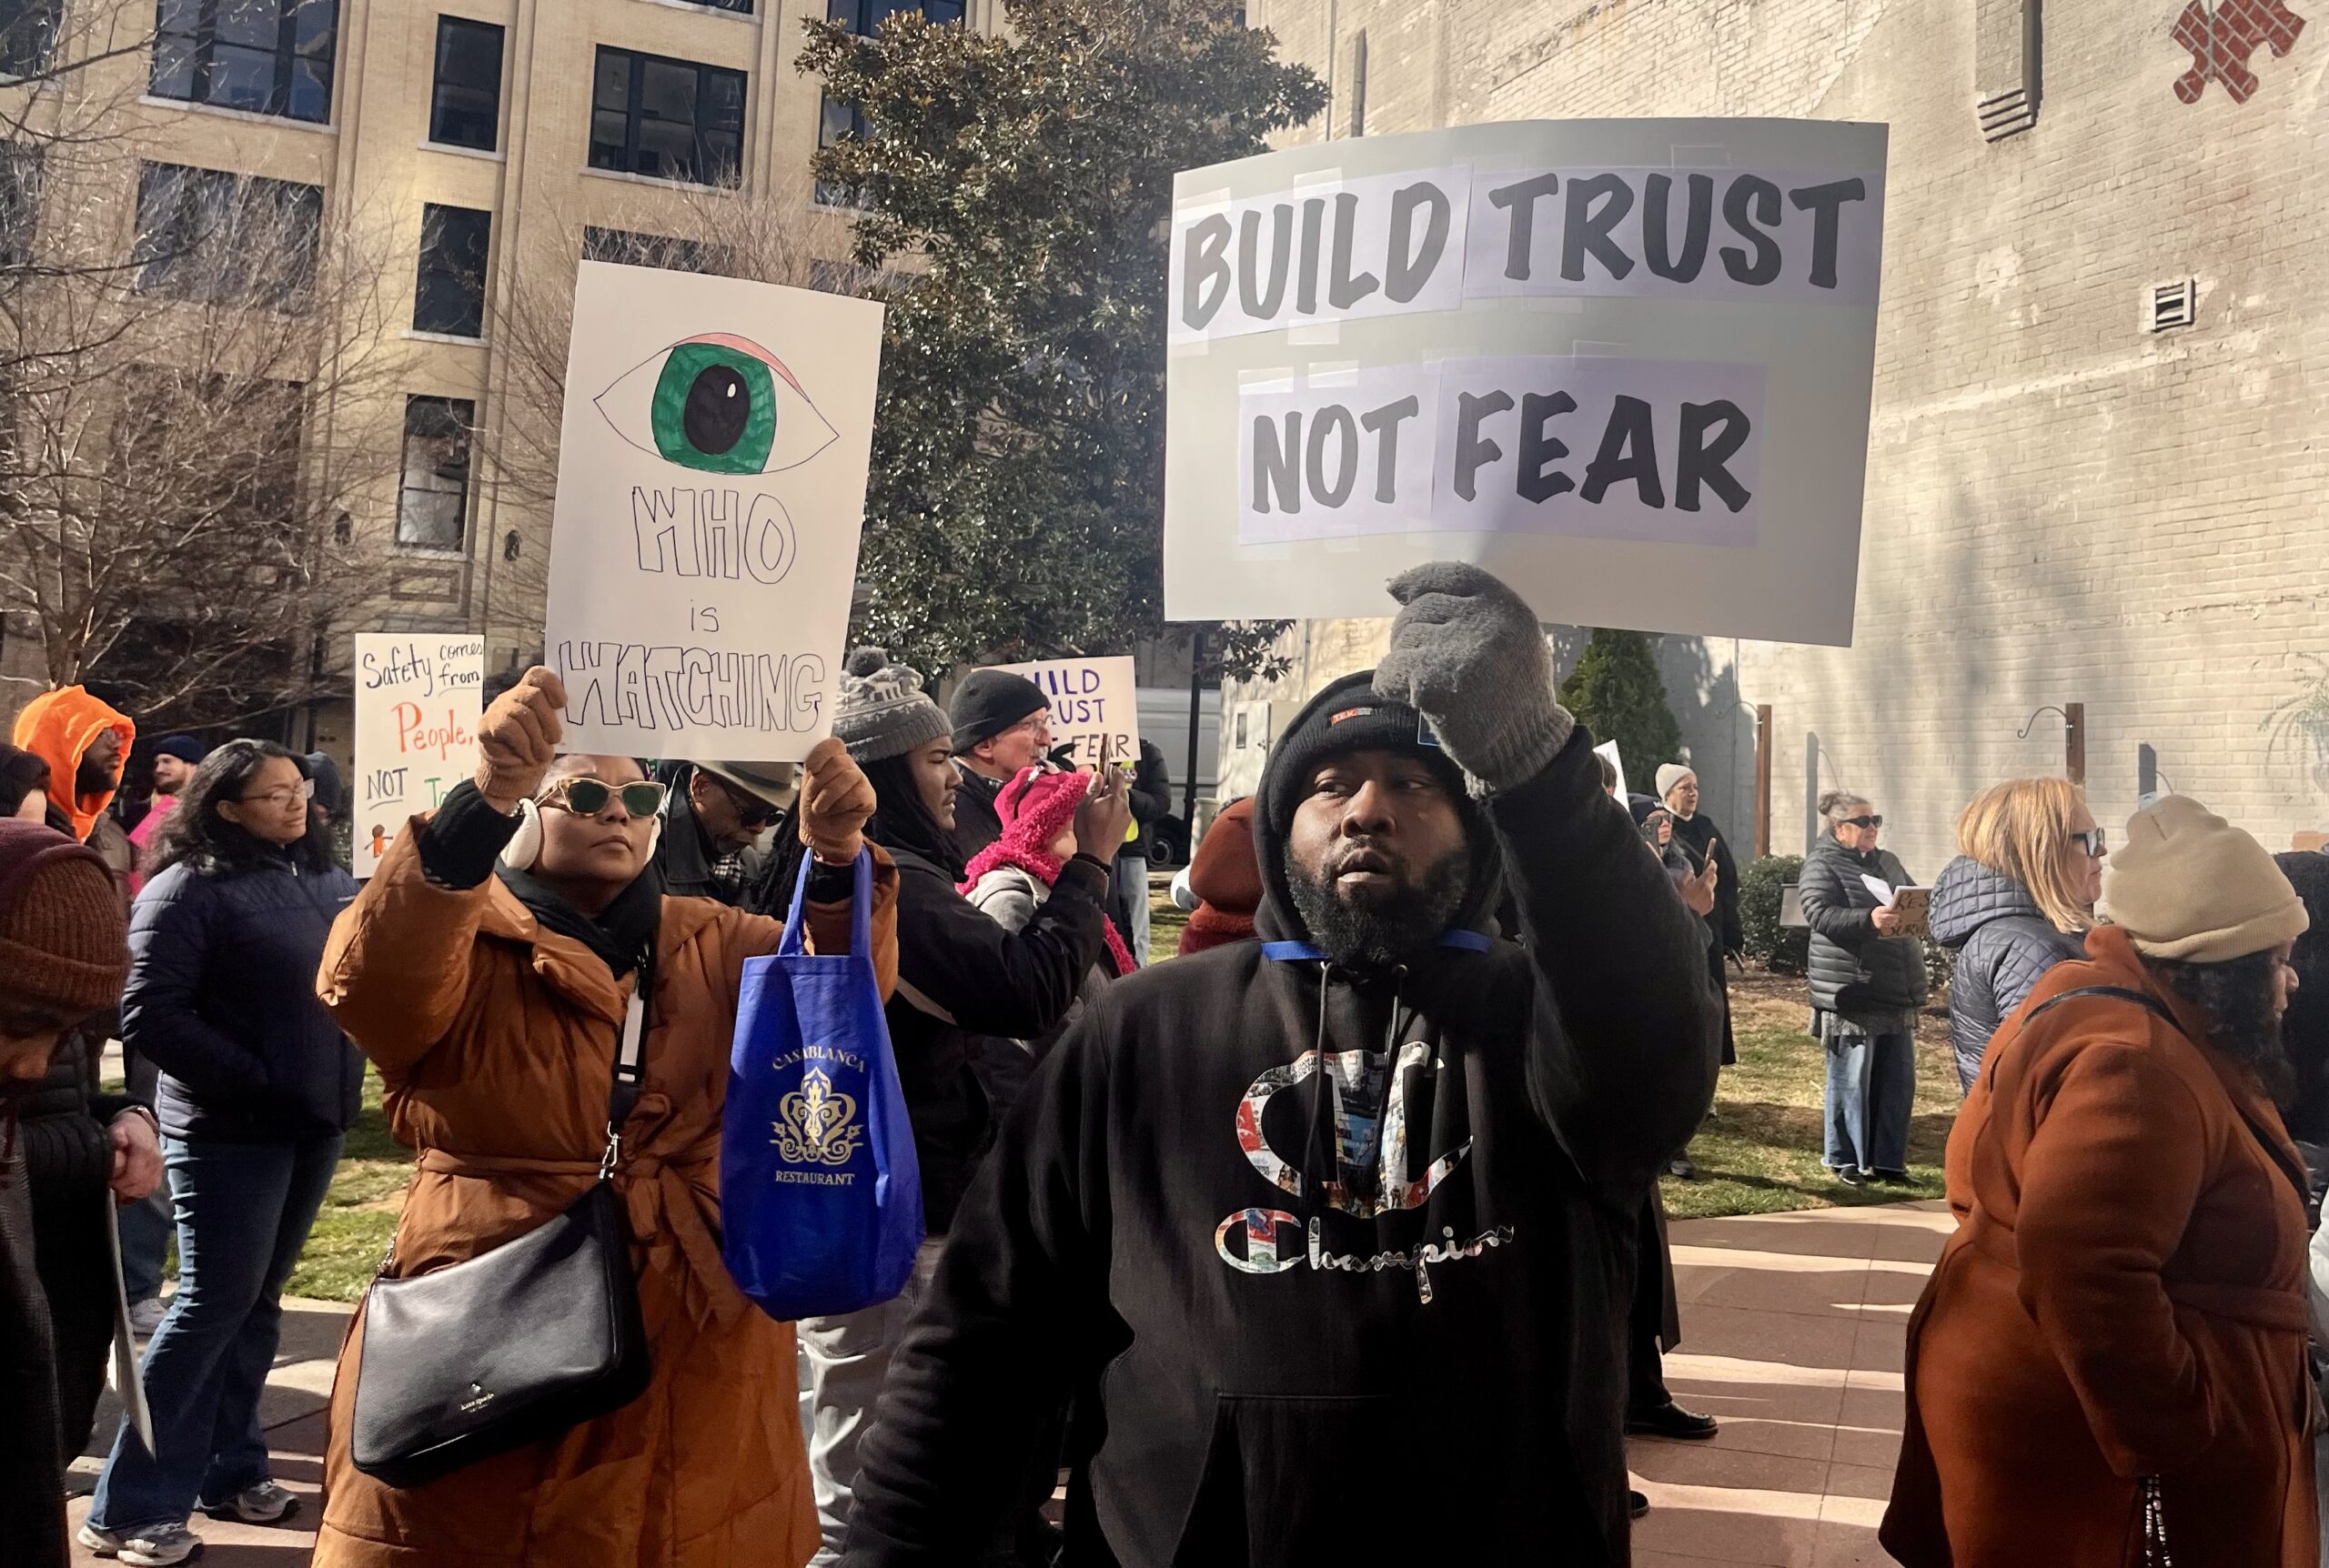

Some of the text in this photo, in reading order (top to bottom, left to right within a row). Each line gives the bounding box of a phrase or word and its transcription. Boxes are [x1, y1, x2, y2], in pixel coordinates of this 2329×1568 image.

[1182, 173, 1865, 330] BUILD TRUST
[1252, 389, 1751, 514] NOT FEAR
[632, 486, 796, 584] WHO
[691, 598, 719, 632] is
[363, 642, 482, 698] Safety comes
[439, 665, 480, 687] from
[559, 640, 825, 733] WATCHING
[390, 701, 474, 760] People,
[367, 767, 408, 800] NOT
[1894, 891, 1930, 910] RES
[772, 1046, 865, 1072] CASABLANCA
[775, 1170, 855, 1186] RESTAURANT
[1215, 1208, 1514, 1304] Champion
